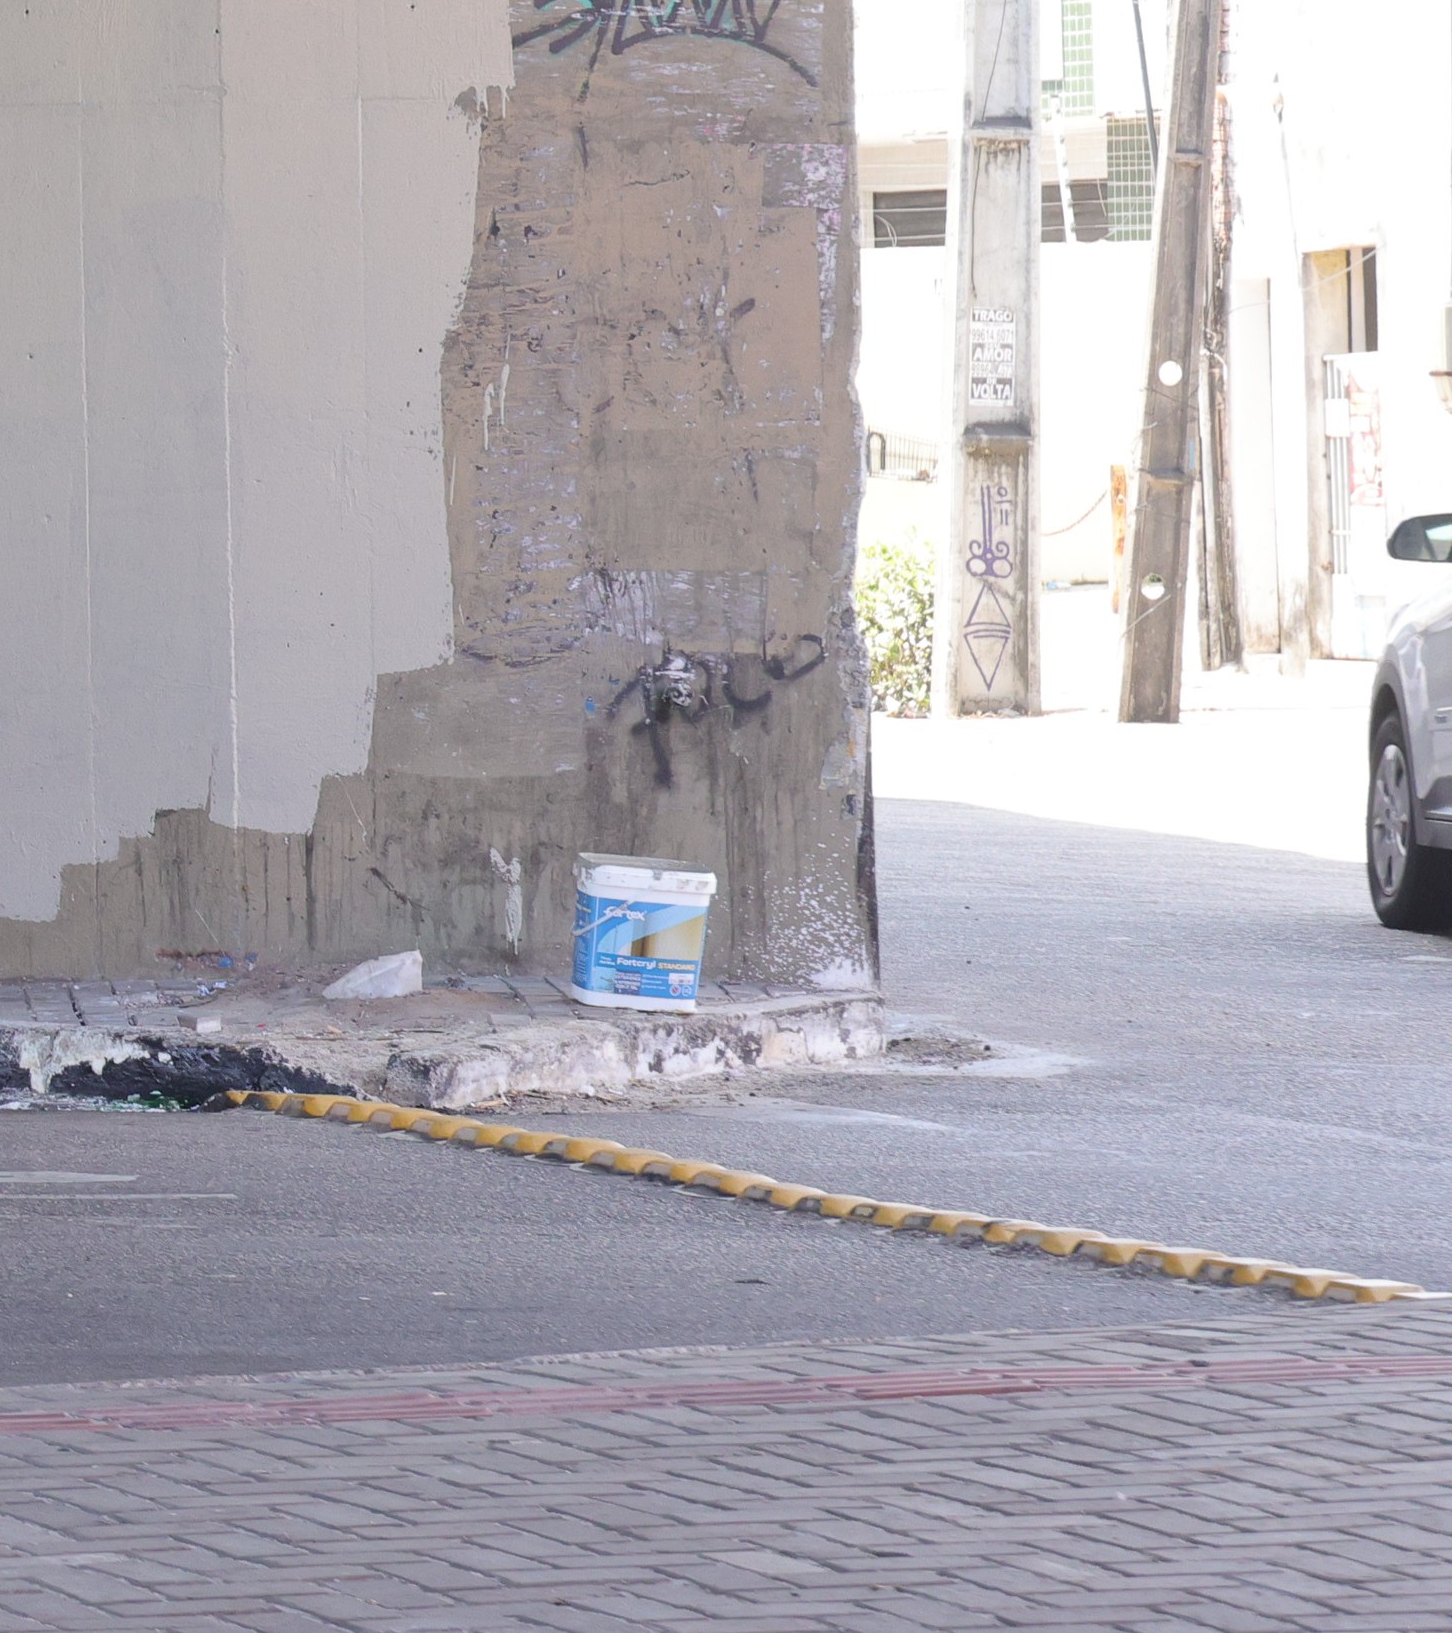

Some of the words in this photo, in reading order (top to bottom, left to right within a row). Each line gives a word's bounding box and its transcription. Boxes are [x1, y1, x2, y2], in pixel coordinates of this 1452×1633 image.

[973, 309, 1013, 322] TRAGO
[973, 348, 1013, 362] AMOR
[971, 383, 1012, 400] VOLTA
[617, 957, 656, 970] Fortcryl
